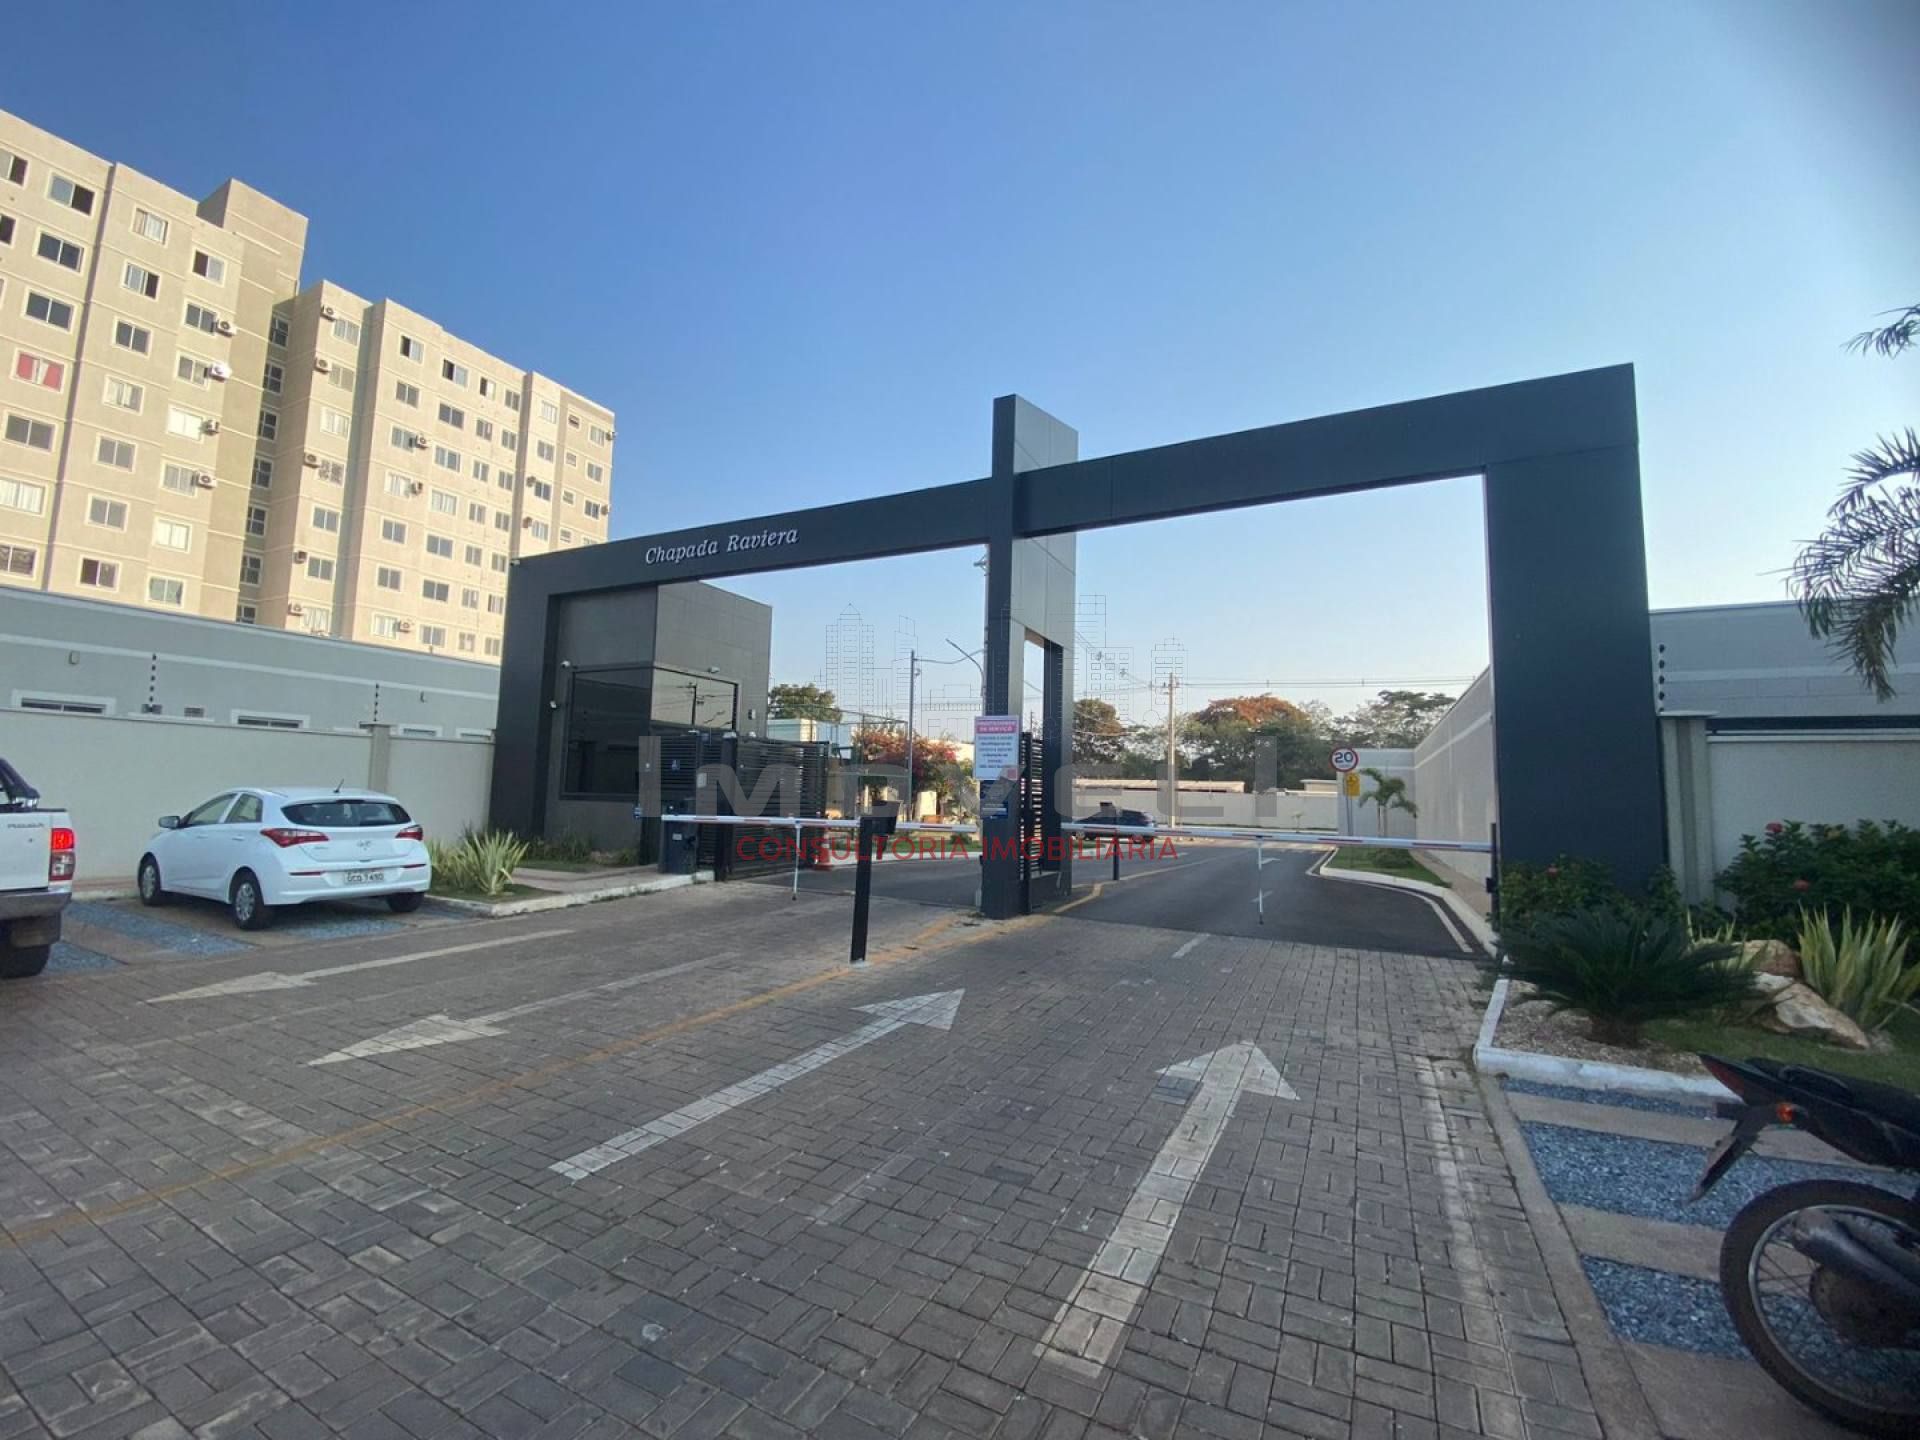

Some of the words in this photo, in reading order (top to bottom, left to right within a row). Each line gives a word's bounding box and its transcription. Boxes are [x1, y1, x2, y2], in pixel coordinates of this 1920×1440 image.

[645, 539, 718, 564] Chapada
[726, 528, 798, 553] Raviera
[1335, 751, 1354, 764] 20
